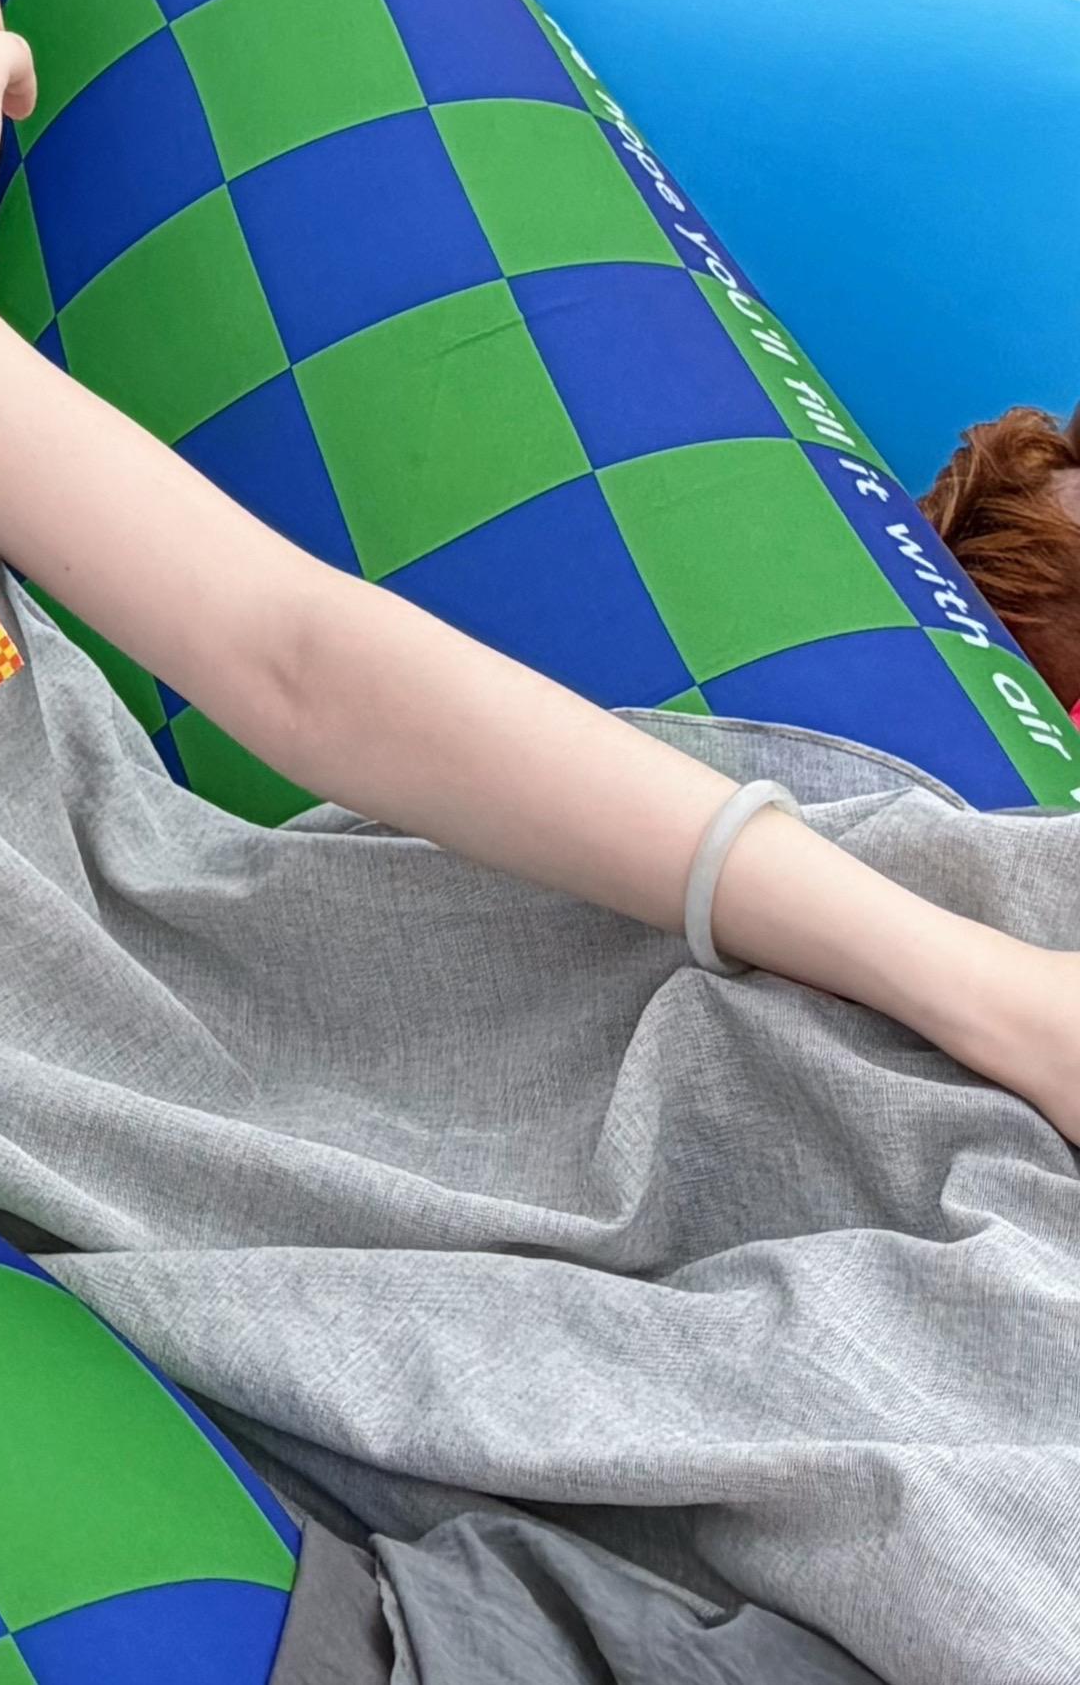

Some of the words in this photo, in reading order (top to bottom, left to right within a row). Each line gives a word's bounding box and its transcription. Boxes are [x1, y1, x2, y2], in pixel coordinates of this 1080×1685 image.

[595, 89, 685, 212] hope
[674, 223, 799, 365] you'll
[784, 377, 856, 448] fill
[838, 457, 890, 502] it
[885, 522, 990, 648] with
[992, 672, 1073, 761] air
